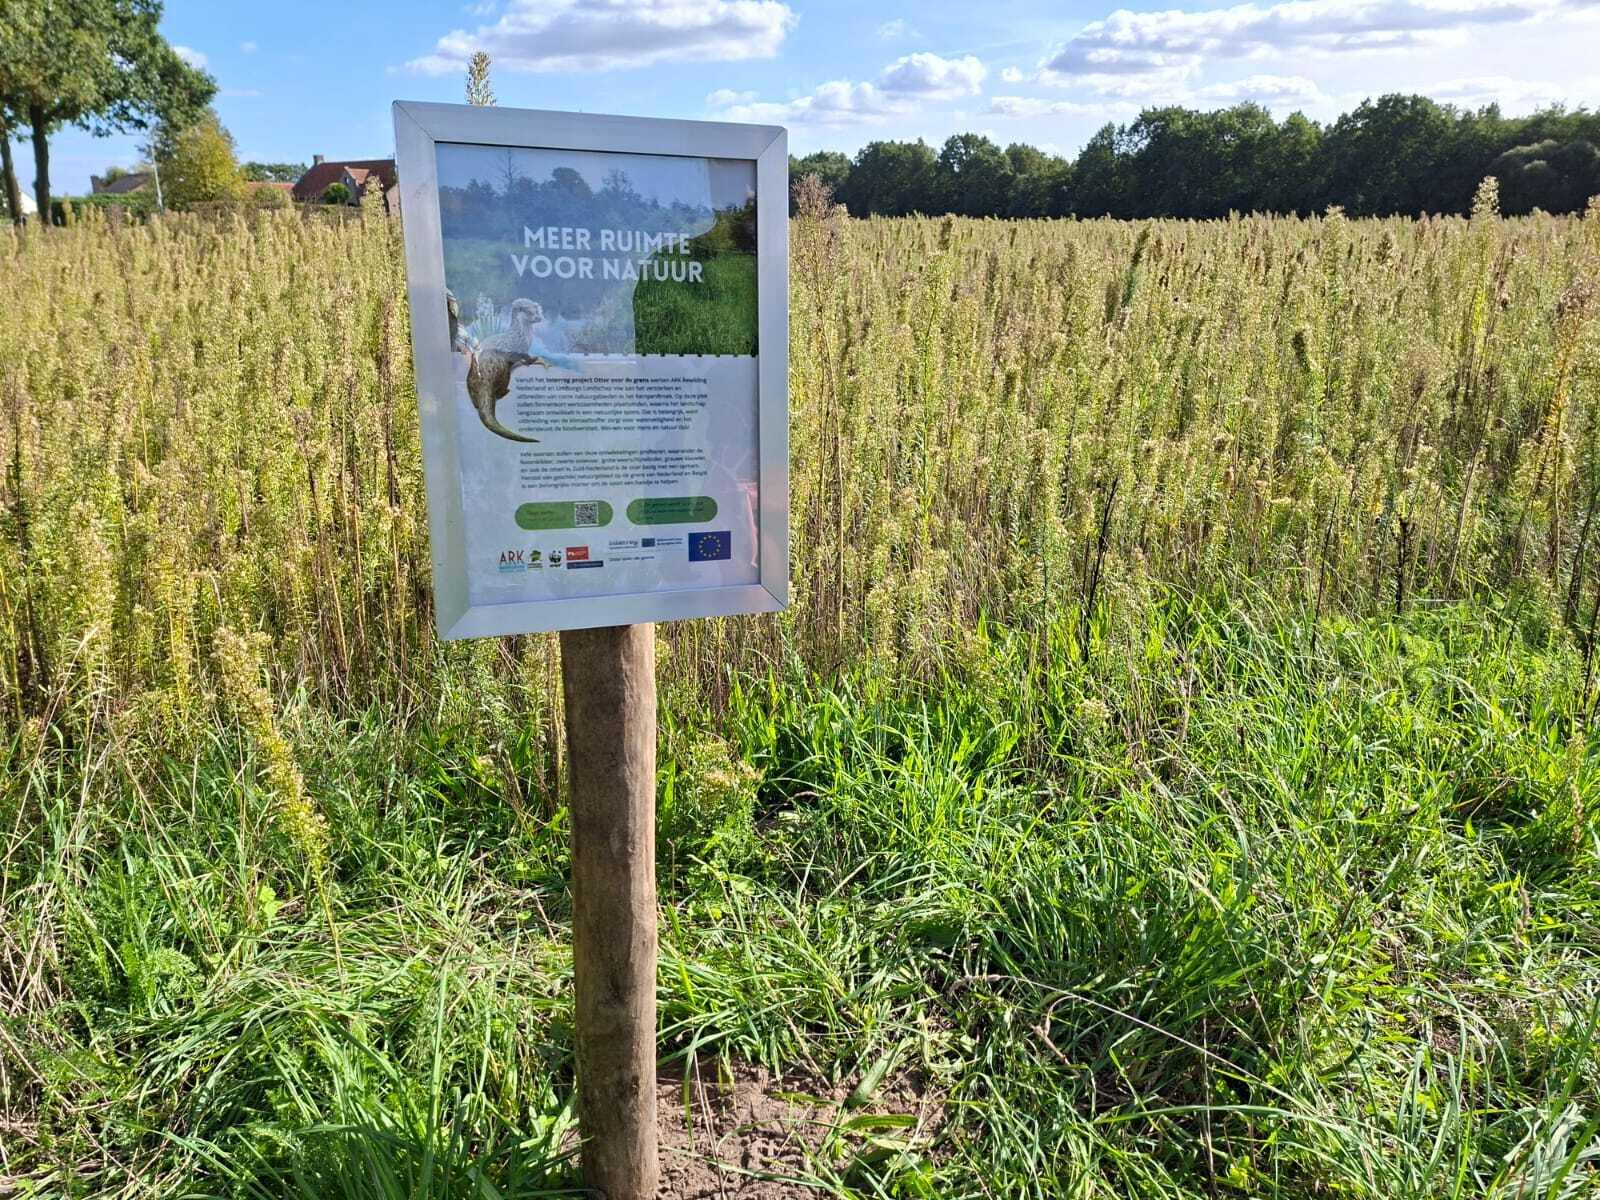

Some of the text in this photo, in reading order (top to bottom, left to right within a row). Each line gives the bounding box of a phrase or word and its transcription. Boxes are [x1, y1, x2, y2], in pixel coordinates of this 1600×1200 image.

[524, 225, 691, 255] MEER RUIMTE
[511, 254, 704, 283] VOOR NATUUR
[500, 550, 525, 563] ARK
